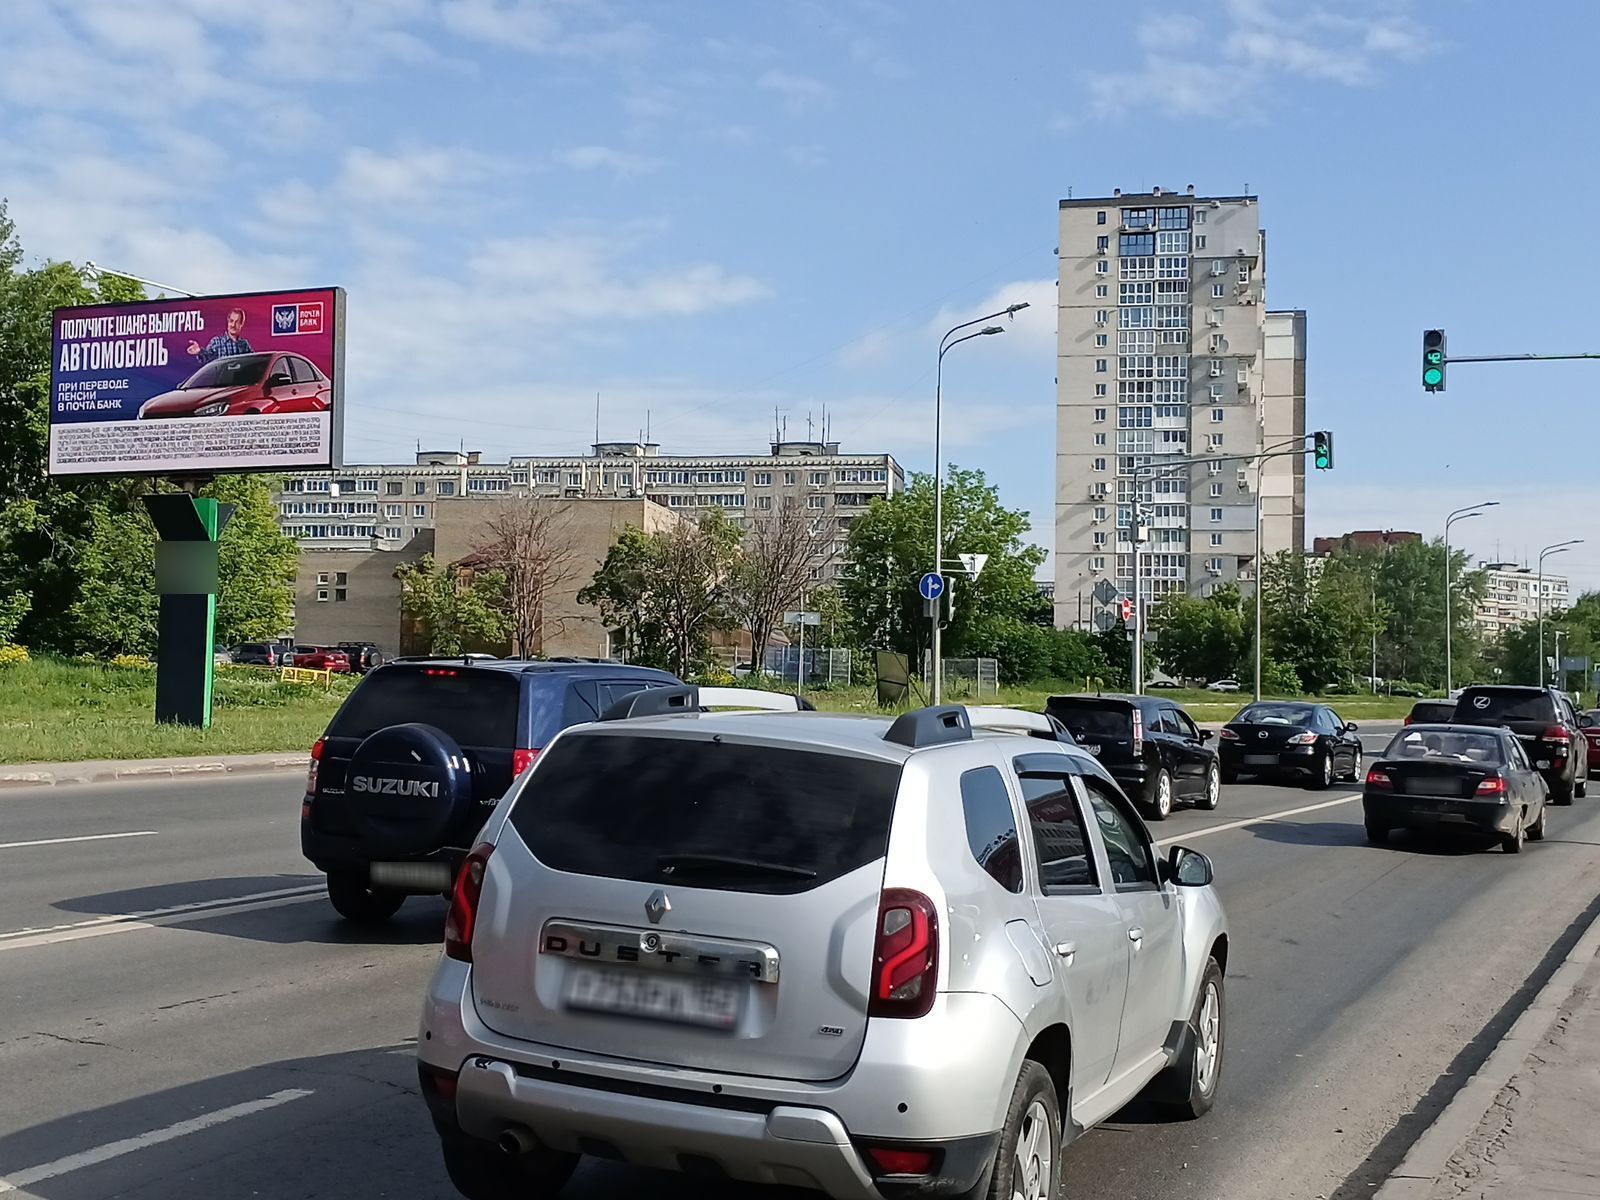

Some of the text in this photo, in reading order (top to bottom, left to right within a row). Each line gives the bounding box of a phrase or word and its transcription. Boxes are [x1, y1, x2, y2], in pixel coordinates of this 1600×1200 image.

[60, 310, 205, 340] ПОЛУЧИТЕ ШАНС ВЫИГРАТЬ
[59, 338, 168, 372] АВТОМОБИЛЬ
[58, 379, 129, 392] ПРИ ПЕРЕВОДЕ
[58, 391, 97, 401] ПЕНСИИ
[57, 399, 122, 412] В ПОЧТА БАНК
[352, 775, 439, 798] SUZUKI
